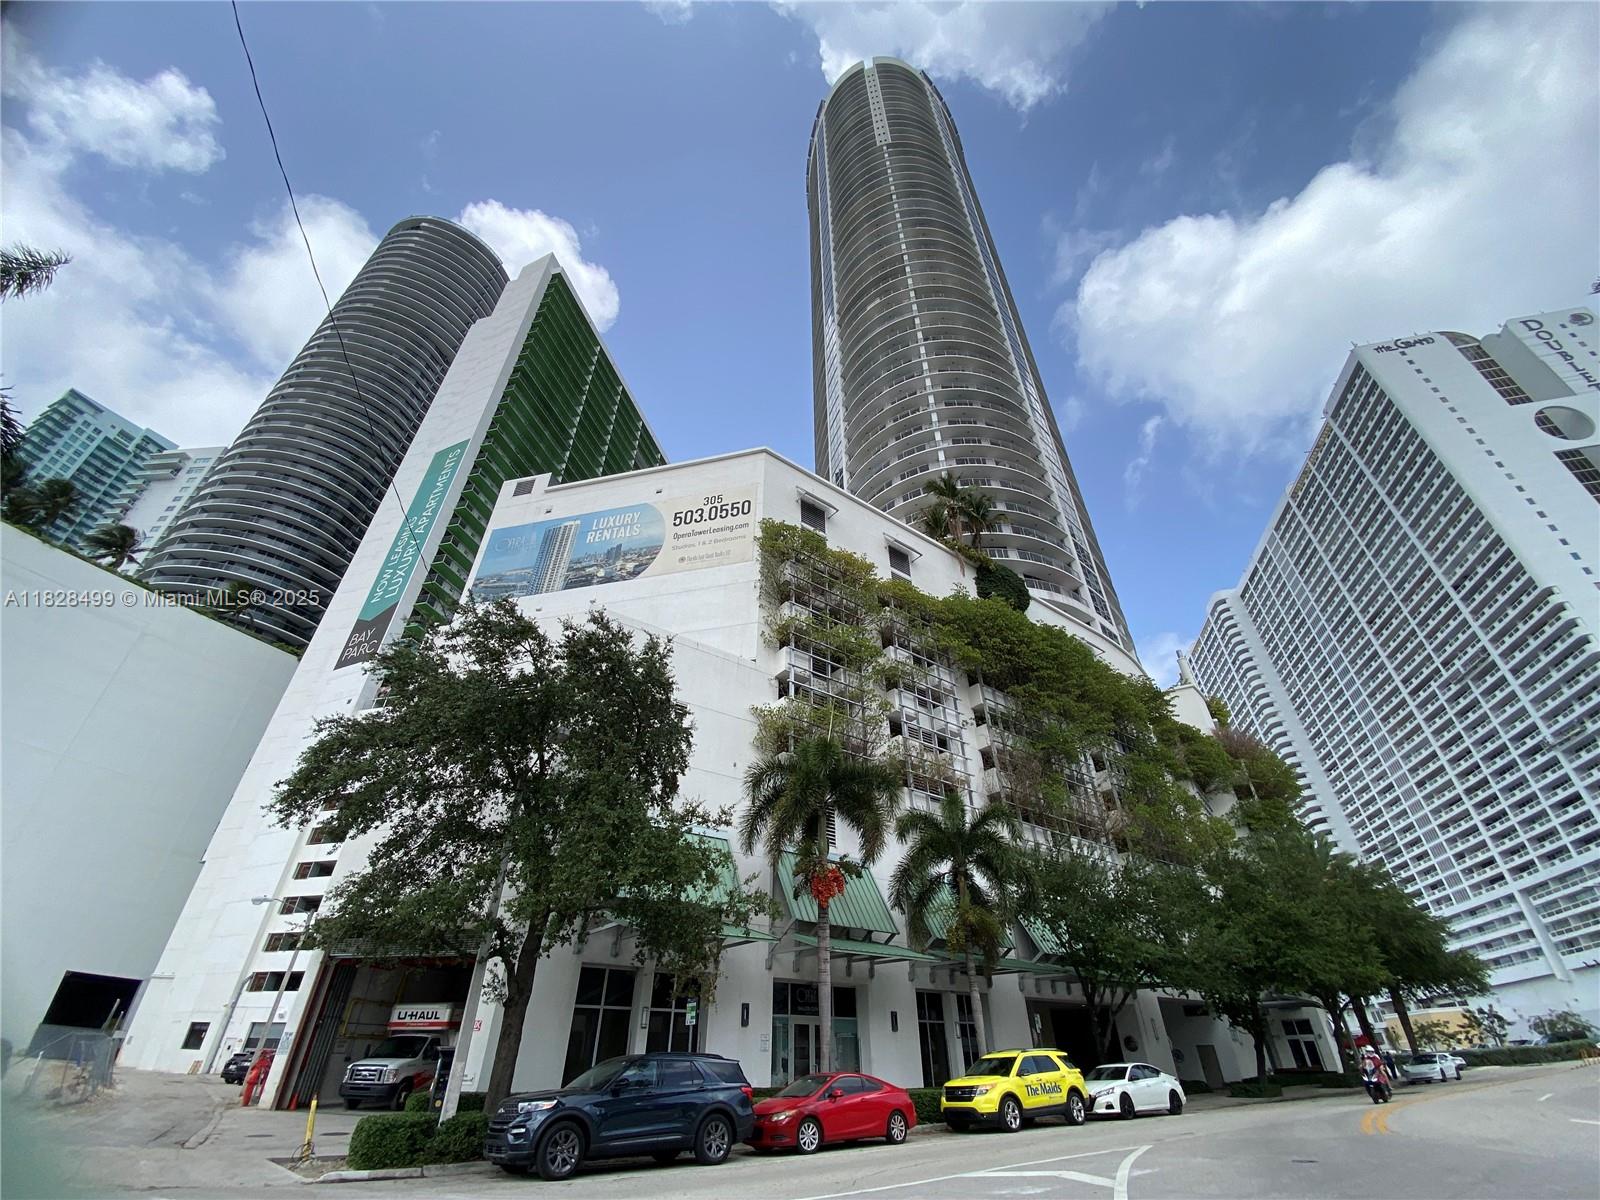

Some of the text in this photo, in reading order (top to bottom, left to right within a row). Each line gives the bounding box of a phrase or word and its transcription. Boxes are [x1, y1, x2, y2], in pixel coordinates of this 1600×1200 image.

[703, 494, 723, 506] 305
[592, 511, 641, 530] LUXURY
[673, 500, 752, 527] 503.0550
[384, 448, 461, 599] LUXURY APARTMENTS
[673, 522, 749, 541] OperaTowerLeasing.com
[586, 523, 641, 544] RENTALS
[372, 515, 418, 603] NOW LEASING
[348, 627, 375, 646] BAY
[342, 640, 377, 661] PARC
[397, 1011, 441, 1020] U-HAUL
[1025, 1081, 1062, 1097] The Maids
